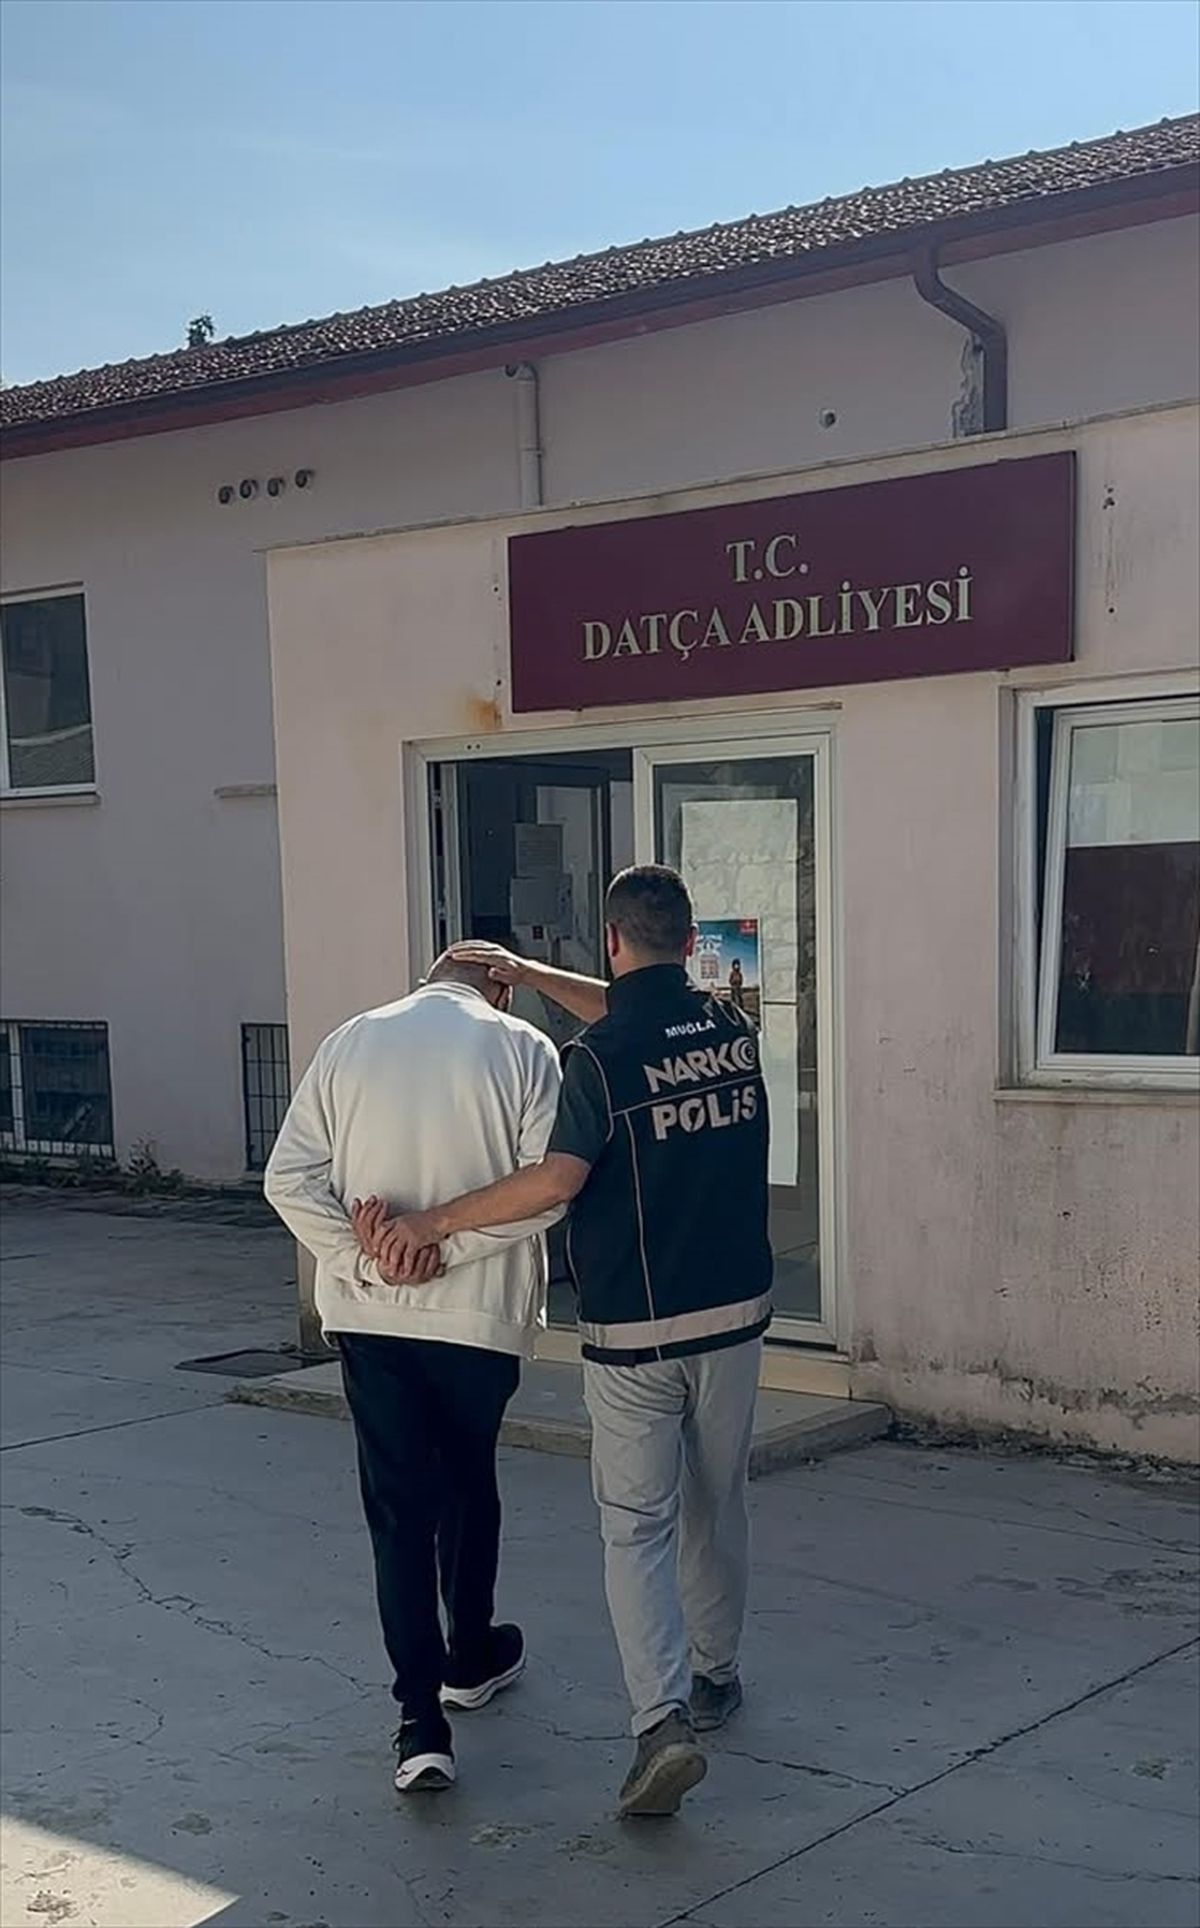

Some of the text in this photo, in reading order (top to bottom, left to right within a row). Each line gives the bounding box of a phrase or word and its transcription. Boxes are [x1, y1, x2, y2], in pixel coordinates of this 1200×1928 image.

[726, 534, 809, 583] T.C.
[582, 566, 974, 661] DATÇA ADLİYESİ
